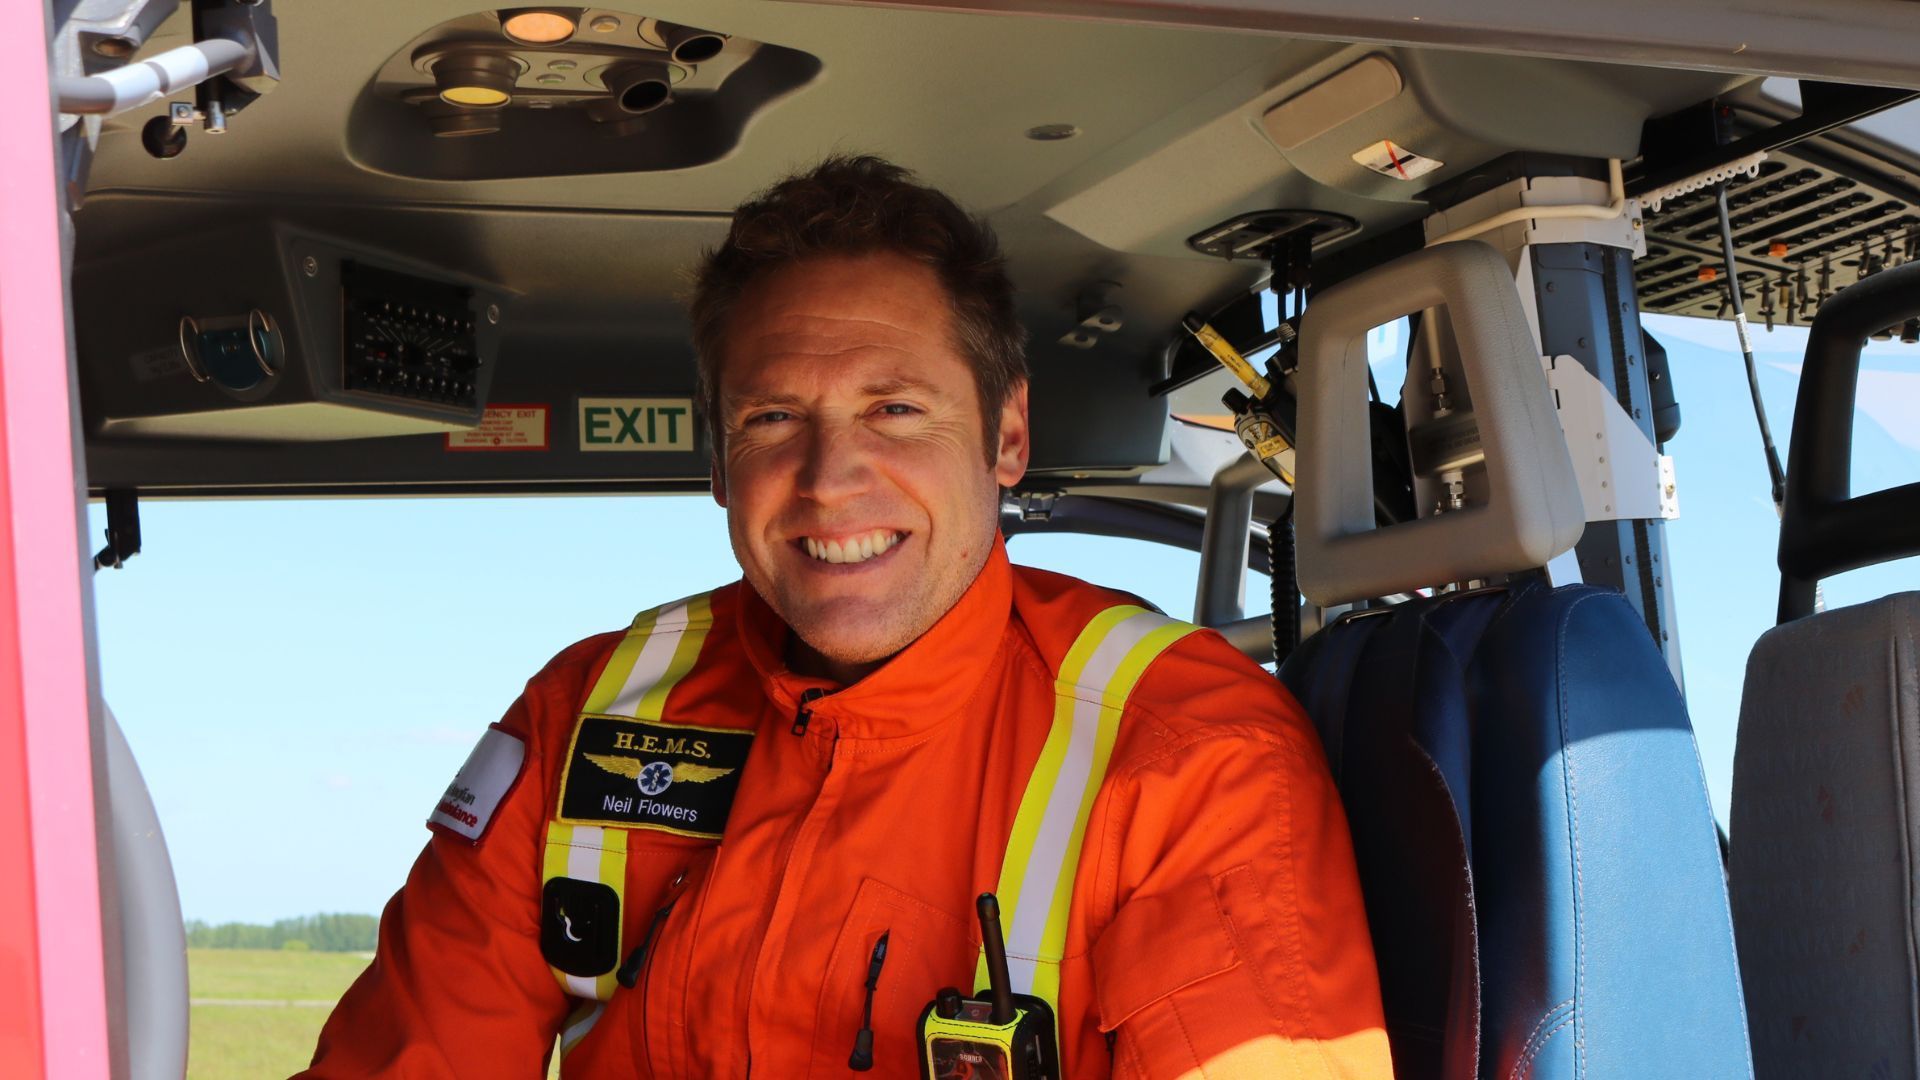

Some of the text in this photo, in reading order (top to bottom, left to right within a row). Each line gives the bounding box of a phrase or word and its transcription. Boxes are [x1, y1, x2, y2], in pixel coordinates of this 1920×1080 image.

[517, 410, 536, 418] EXIT
[584, 407, 687, 444] EXIT
[613, 731, 711, 759] H.E.M.S.
[602, 795, 698, 822] Neil Flowers
